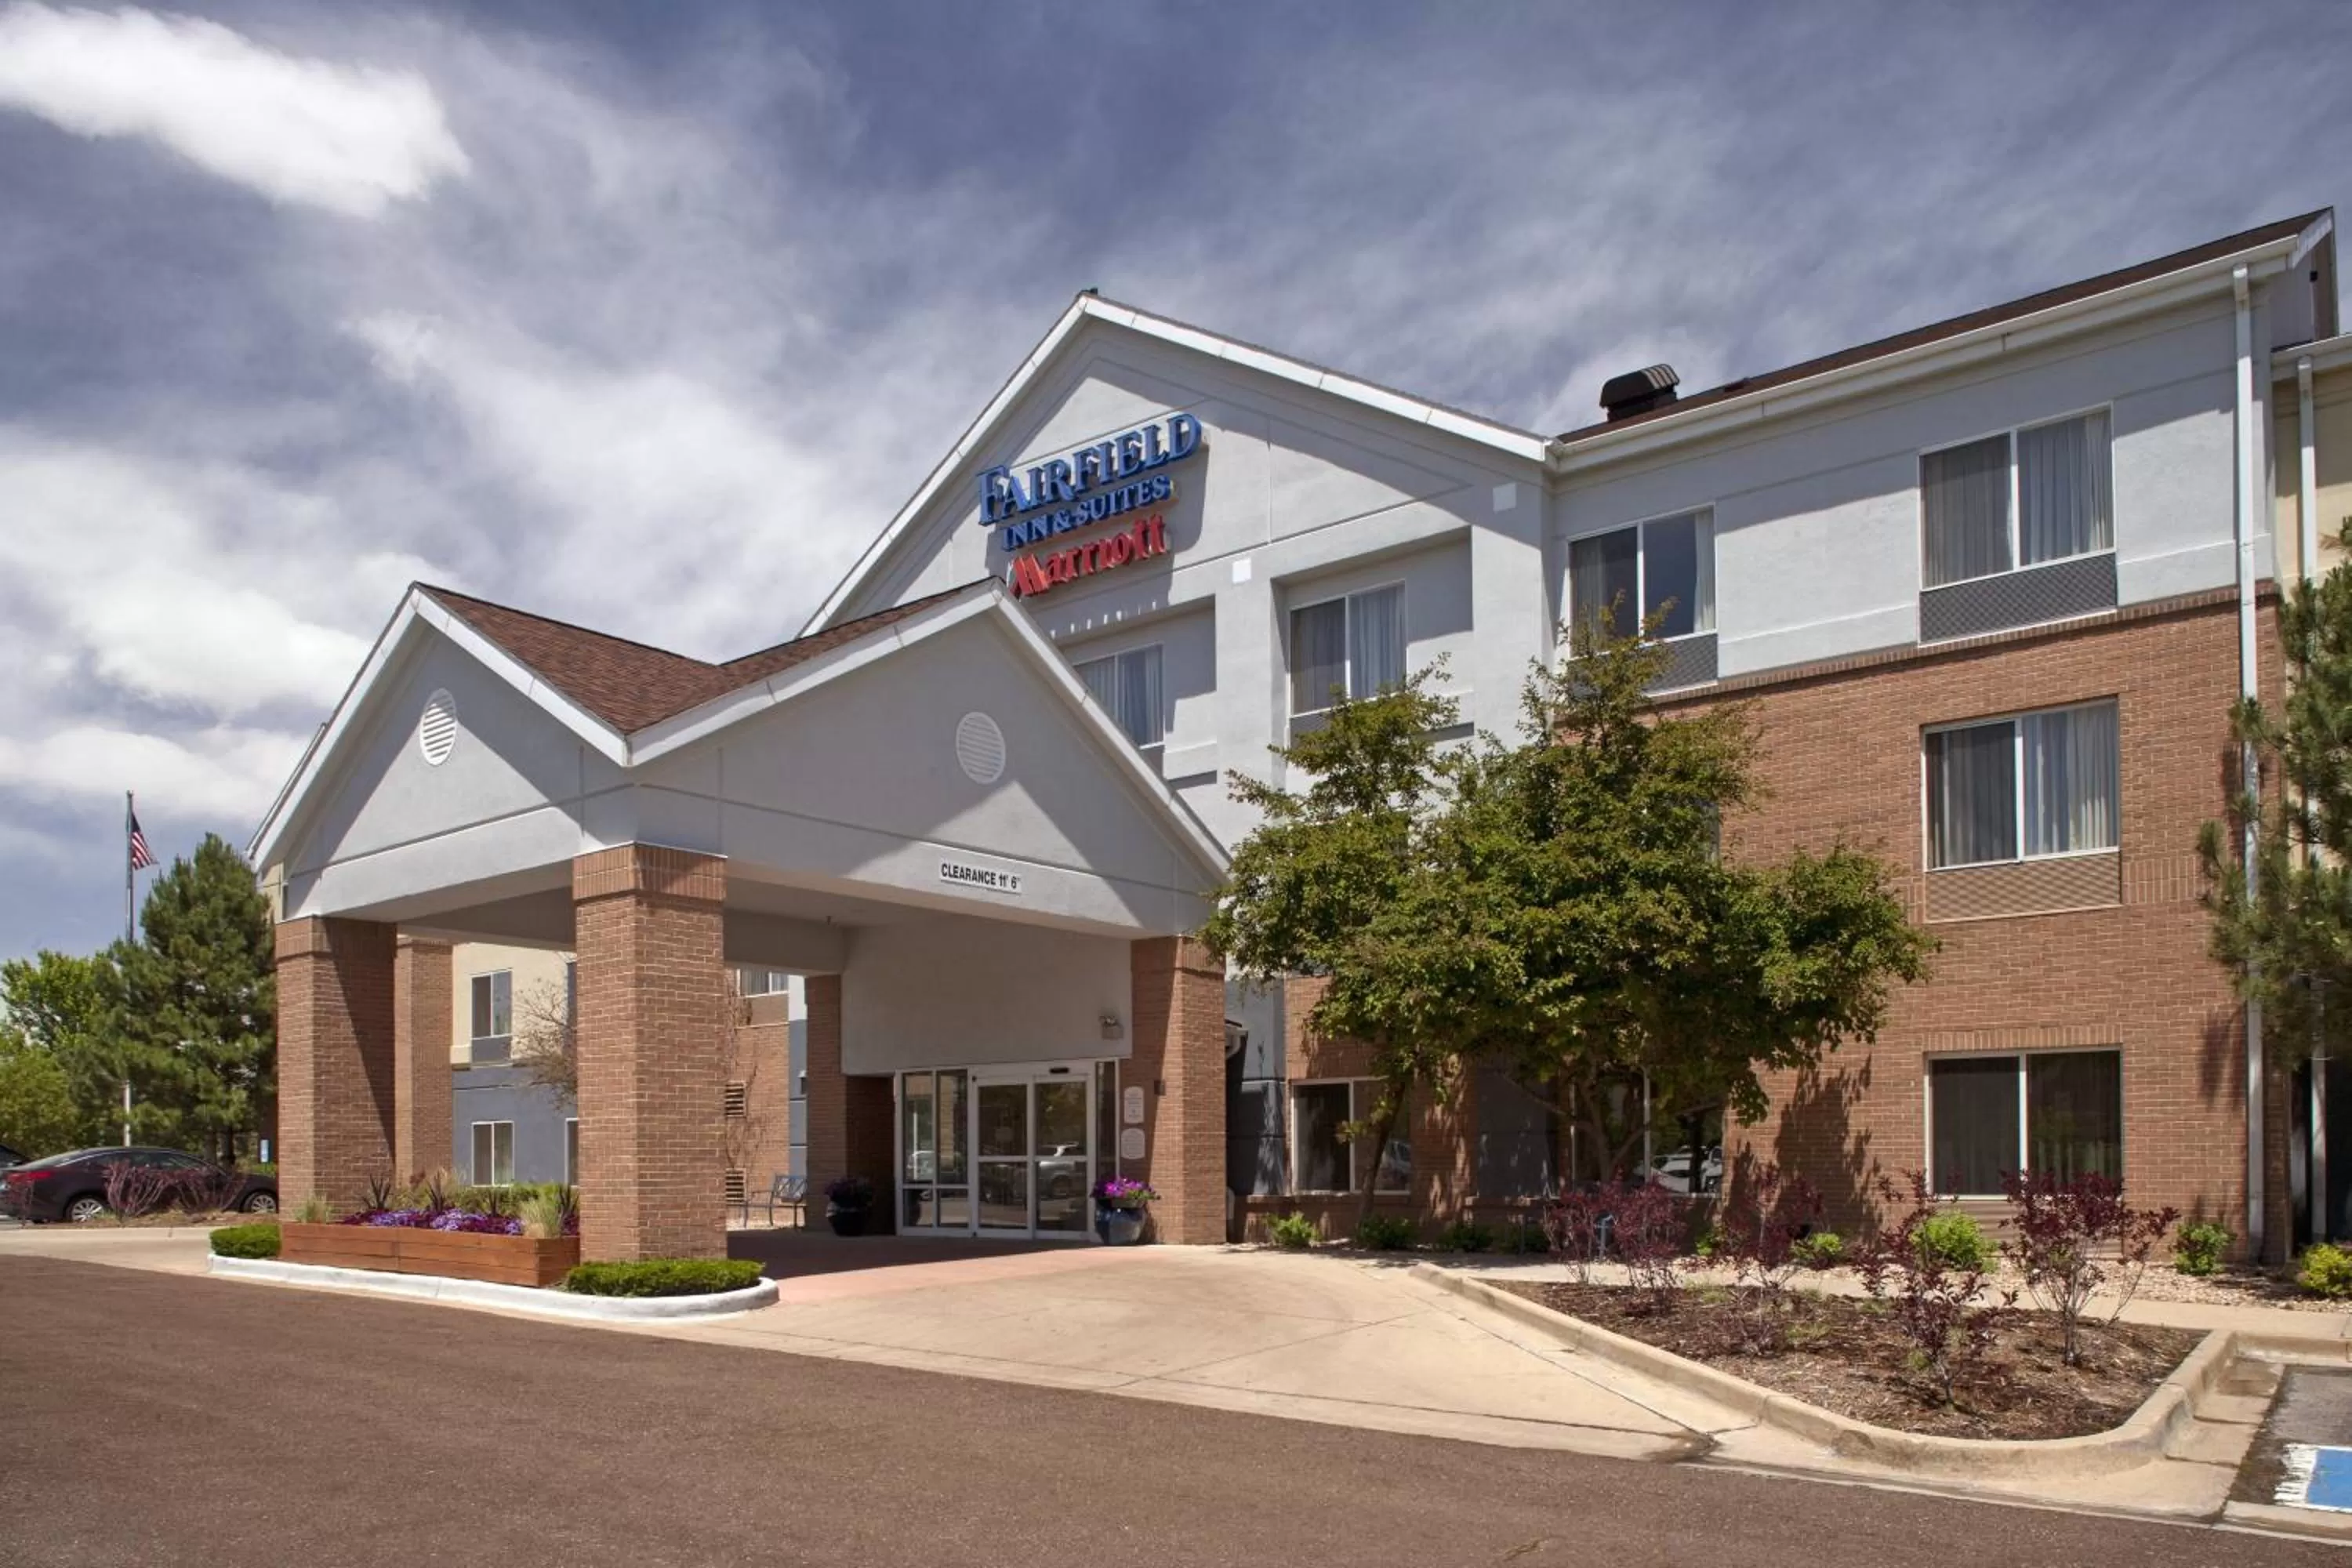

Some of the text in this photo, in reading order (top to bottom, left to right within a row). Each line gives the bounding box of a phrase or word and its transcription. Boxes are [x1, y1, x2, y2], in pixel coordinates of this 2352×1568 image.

[978, 412, 1202, 527] FAIRFIELD
[1008, 514, 1167, 597] Marriott
[941, 863, 996, 886] CLEARANCE
